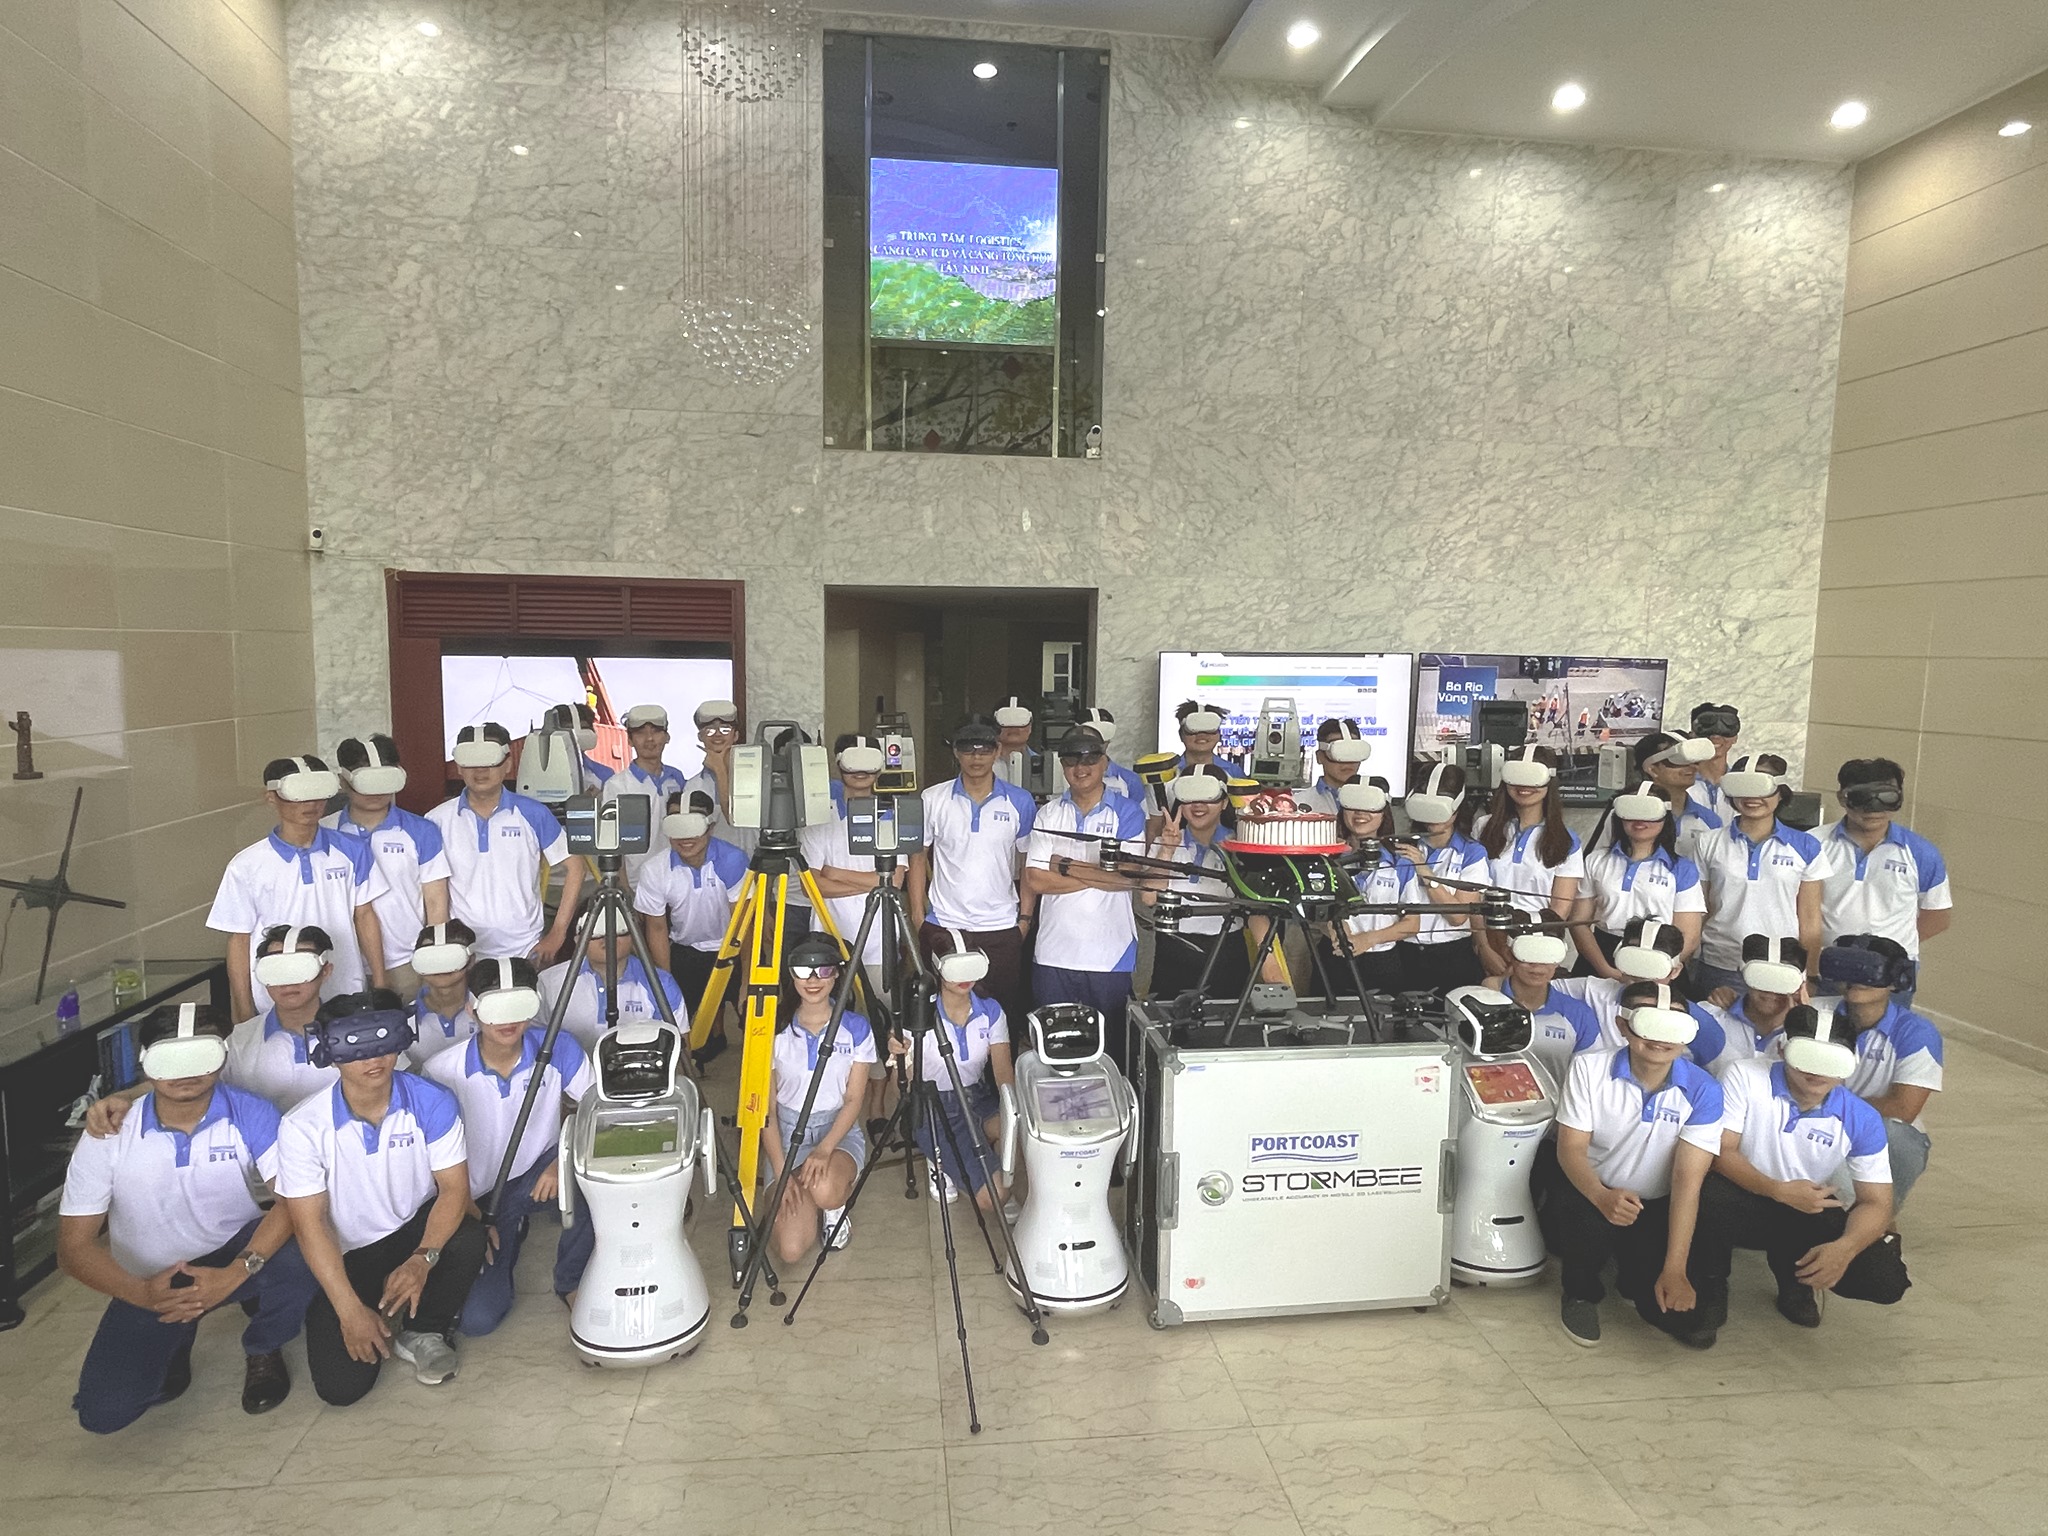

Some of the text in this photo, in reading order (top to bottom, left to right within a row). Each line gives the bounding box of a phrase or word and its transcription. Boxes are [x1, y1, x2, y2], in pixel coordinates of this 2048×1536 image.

[900, 231, 937, 242] TRUNG
[969, 234, 1023, 247] LOGISTICS
[1252, 1133, 1359, 1151] PORTCOAST
[1060, 1148, 1100, 1157] PORTCOAST
[1243, 1167, 1422, 1193] STORMBEE
